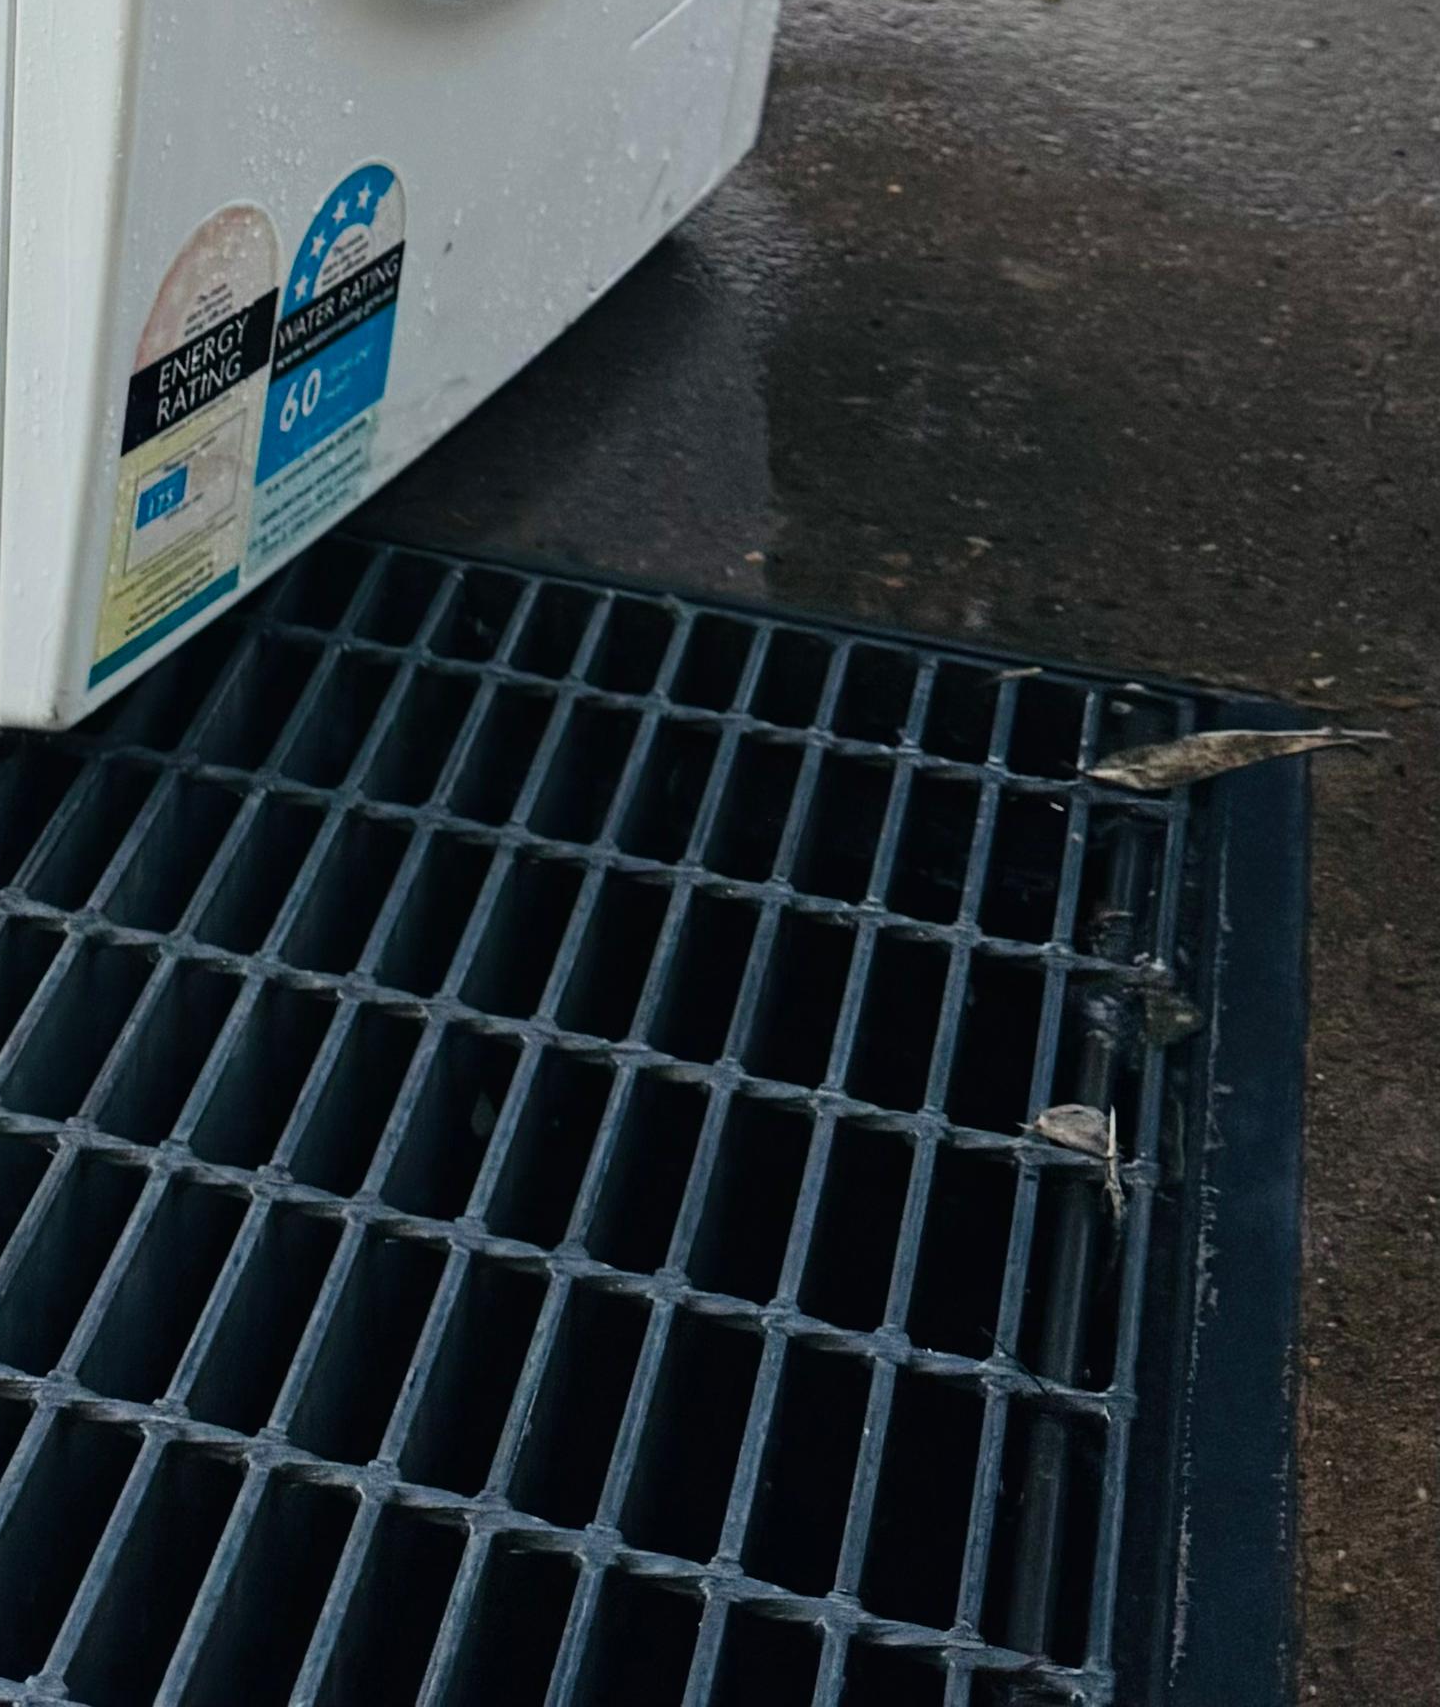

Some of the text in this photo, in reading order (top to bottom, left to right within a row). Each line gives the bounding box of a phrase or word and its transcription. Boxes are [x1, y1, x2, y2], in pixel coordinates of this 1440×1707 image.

[278, 296, 335, 349] WATER
[339, 253, 400, 311] RATING
[156, 350, 242, 428] RATING
[158, 313, 249, 394] ENERGY
[279, 368, 322, 433] 60
